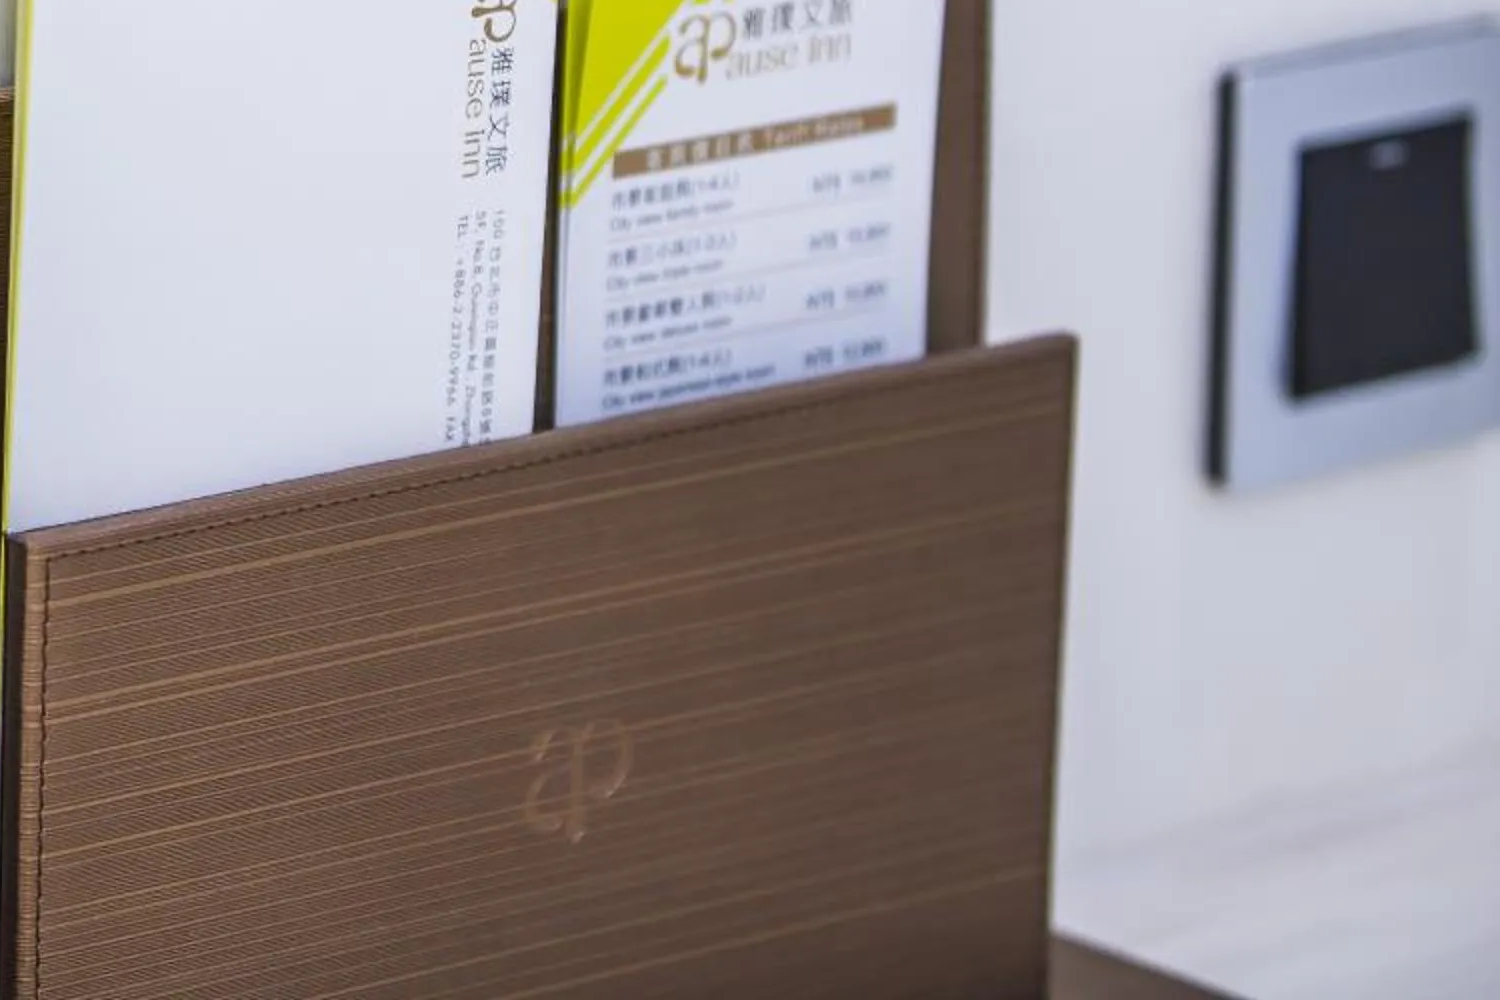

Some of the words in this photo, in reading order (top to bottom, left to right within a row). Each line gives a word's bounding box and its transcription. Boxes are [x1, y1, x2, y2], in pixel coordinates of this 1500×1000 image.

[461, 129, 485, 179] inn
[485, 47, 515, 175] 雅璞文旅
